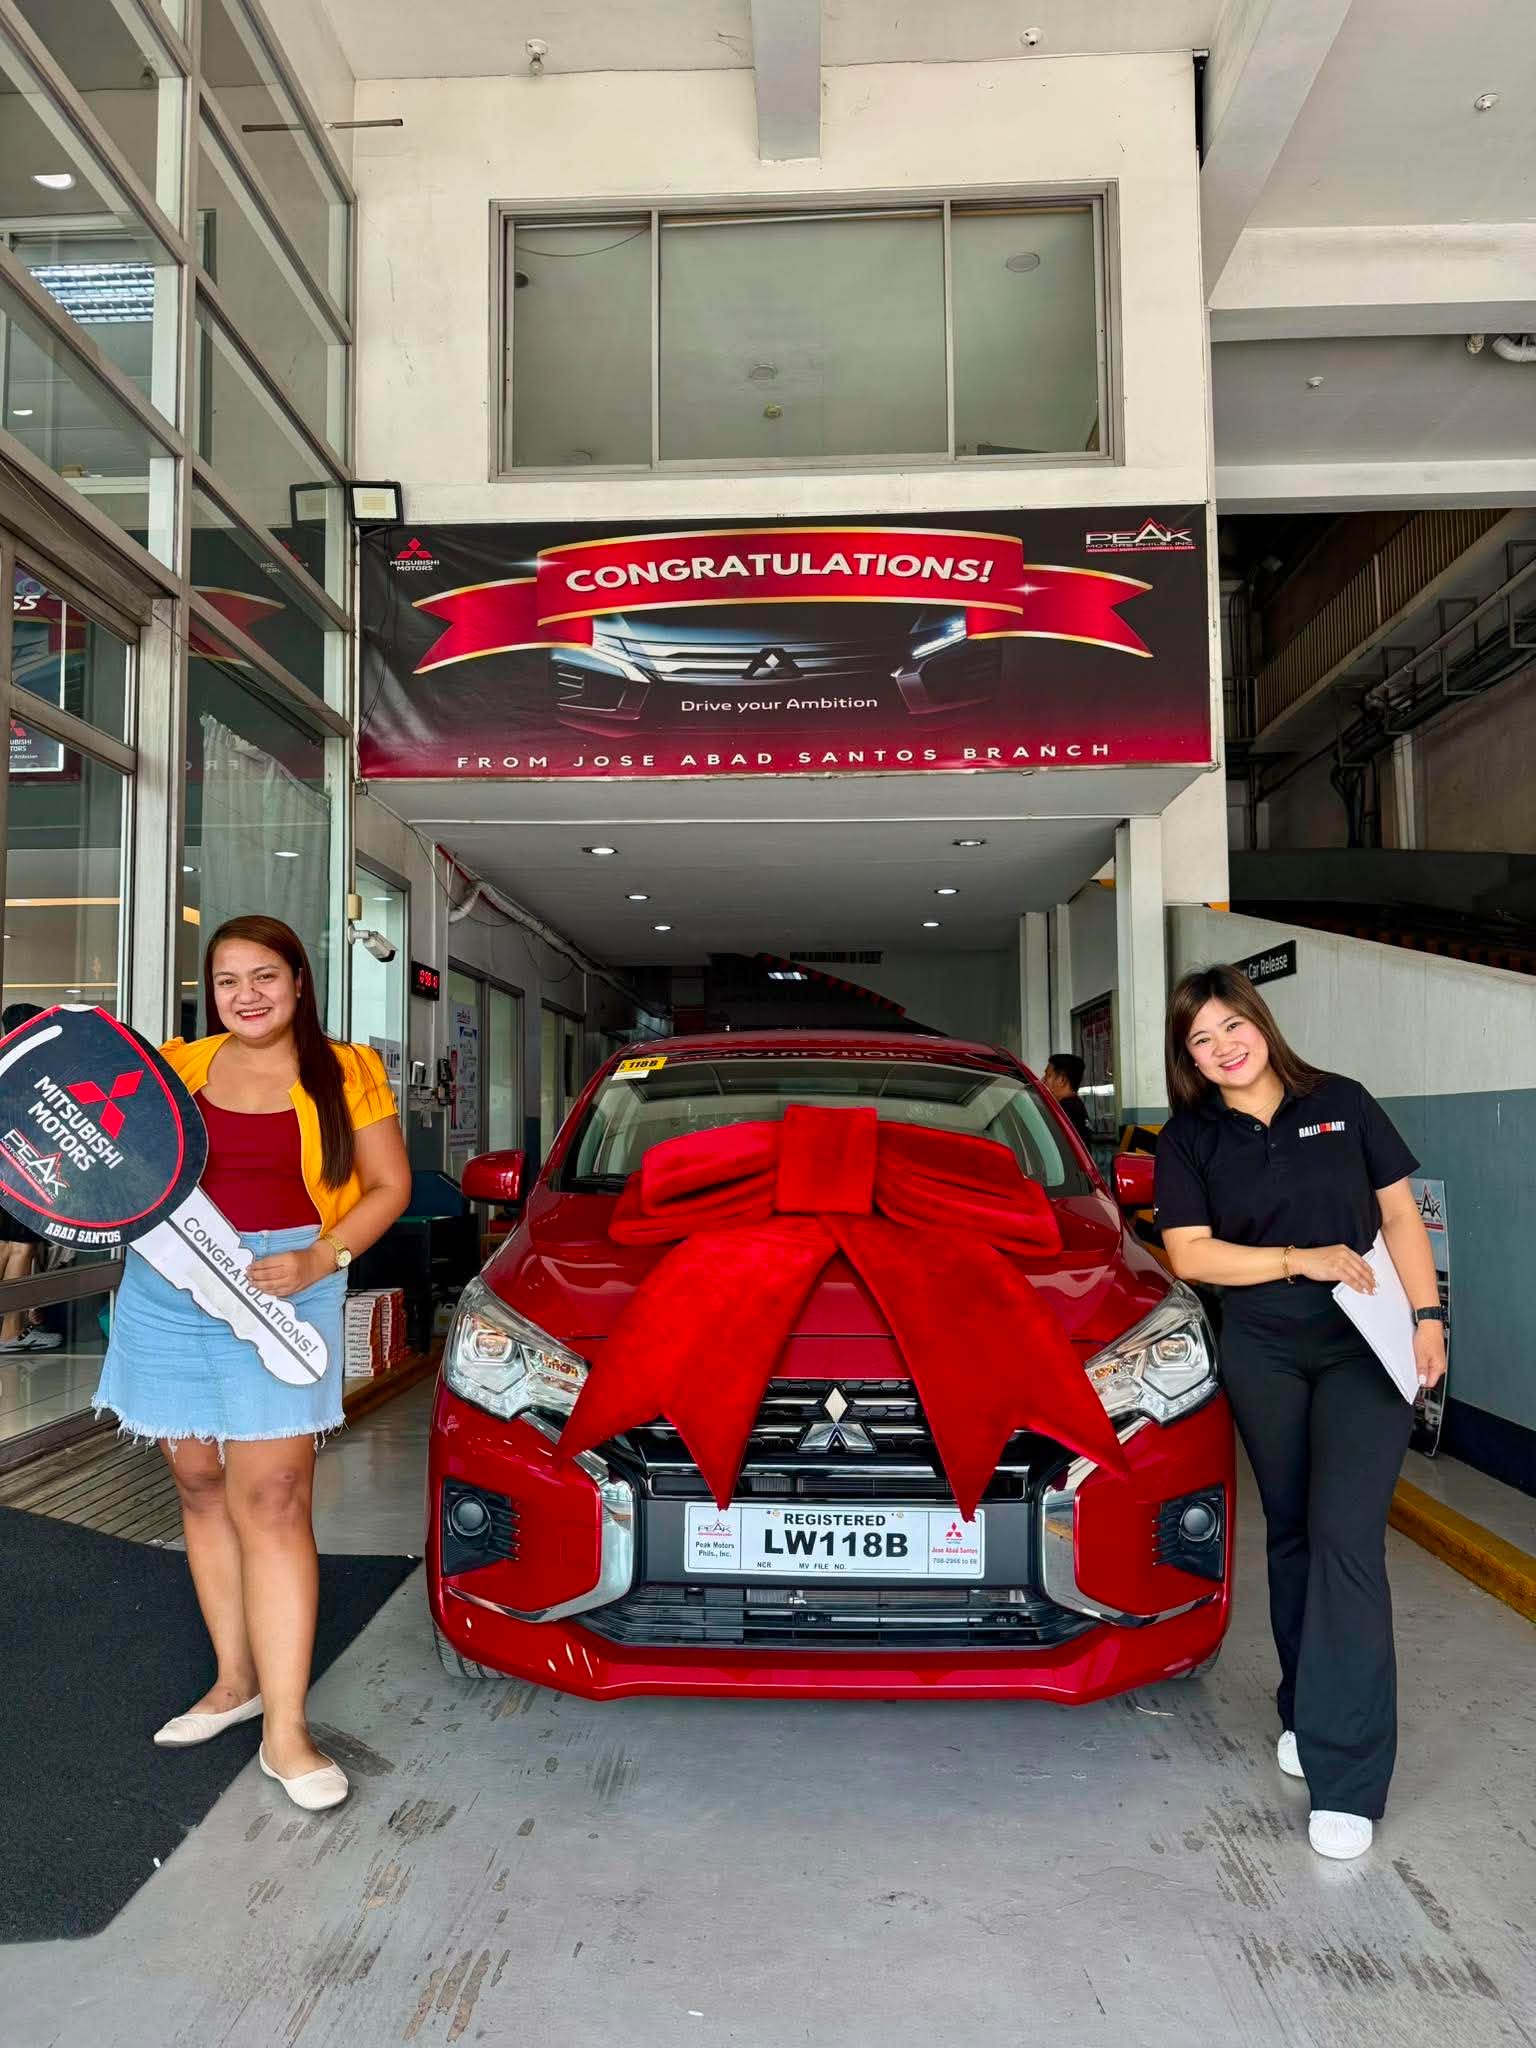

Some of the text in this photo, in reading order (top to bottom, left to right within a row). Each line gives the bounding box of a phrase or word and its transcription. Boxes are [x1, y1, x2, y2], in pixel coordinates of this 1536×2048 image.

[1085, 523, 1193, 545] PEAK
[389, 559, 440, 567] MITSUBISHI
[565, 552, 994, 593] CONGRATULATIONS!
[681, 697, 878, 713] Drive your Ambition
[457, 743, 1109, 769] FROM JOSE ABAD SANTOS BRANCH
[1248, 962, 1260, 980] Car
[1260, 953, 1288, 977] Release
[33, 1075, 124, 1169] MITSUBISHI
[28, 1101, 97, 1171] MOTORS
[2, 1128, 68, 1197] PEAK
[44, 1222, 122, 1244] ABAD SANTOS
[183, 1216, 319, 1357] CONGRATULATIONS!
[784, 1513, 886, 1526] REGISTERED
[695, 1541, 735, 1550] Peak Motors
[764, 1529, 909, 1558] LW118B
